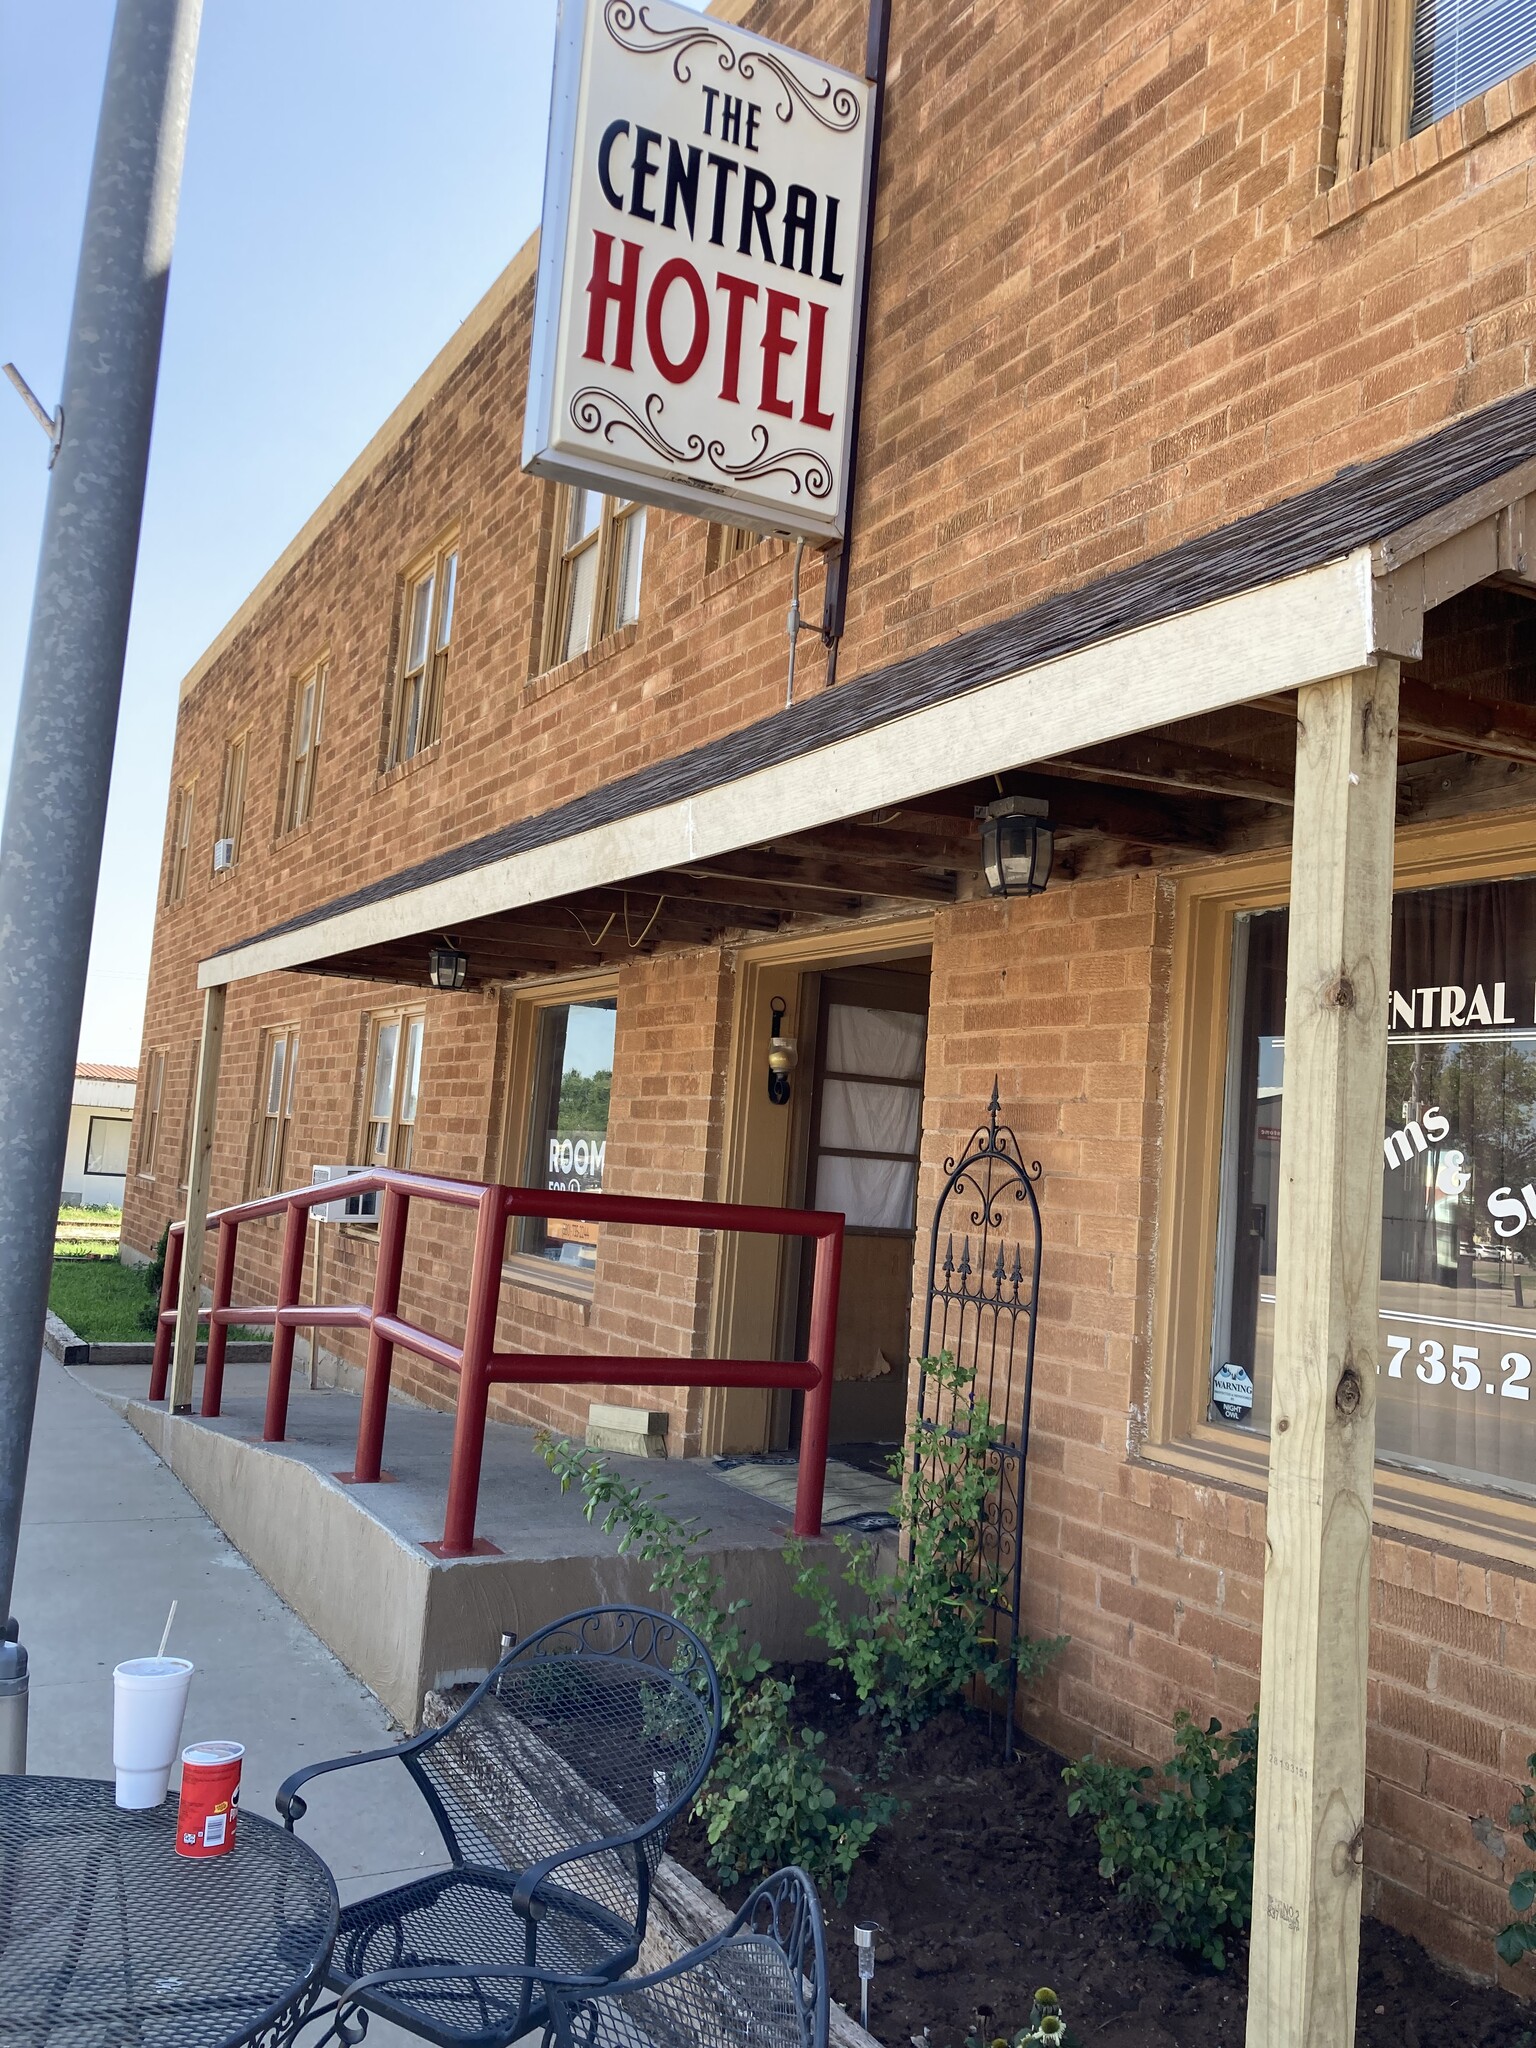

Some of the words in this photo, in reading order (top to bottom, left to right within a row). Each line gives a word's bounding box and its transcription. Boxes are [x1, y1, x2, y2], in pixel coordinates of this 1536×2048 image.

[701, 84, 762, 152] THE
[597, 118, 844, 286] CENTRAL
[582, 229, 835, 431] HOTEL
[1388, 982, 1515, 1030] NTRAL
[549, 1139, 606, 1176] ROOM
[1383, 1106, 1450, 1171] ms
[1438, 1150, 1471, 1195] &
[1214, 1380, 1252, 1394] WARNING
[1223, 1403, 1242, 1413] NIGHT
[1225, 1411, 1240, 1420] OWL
